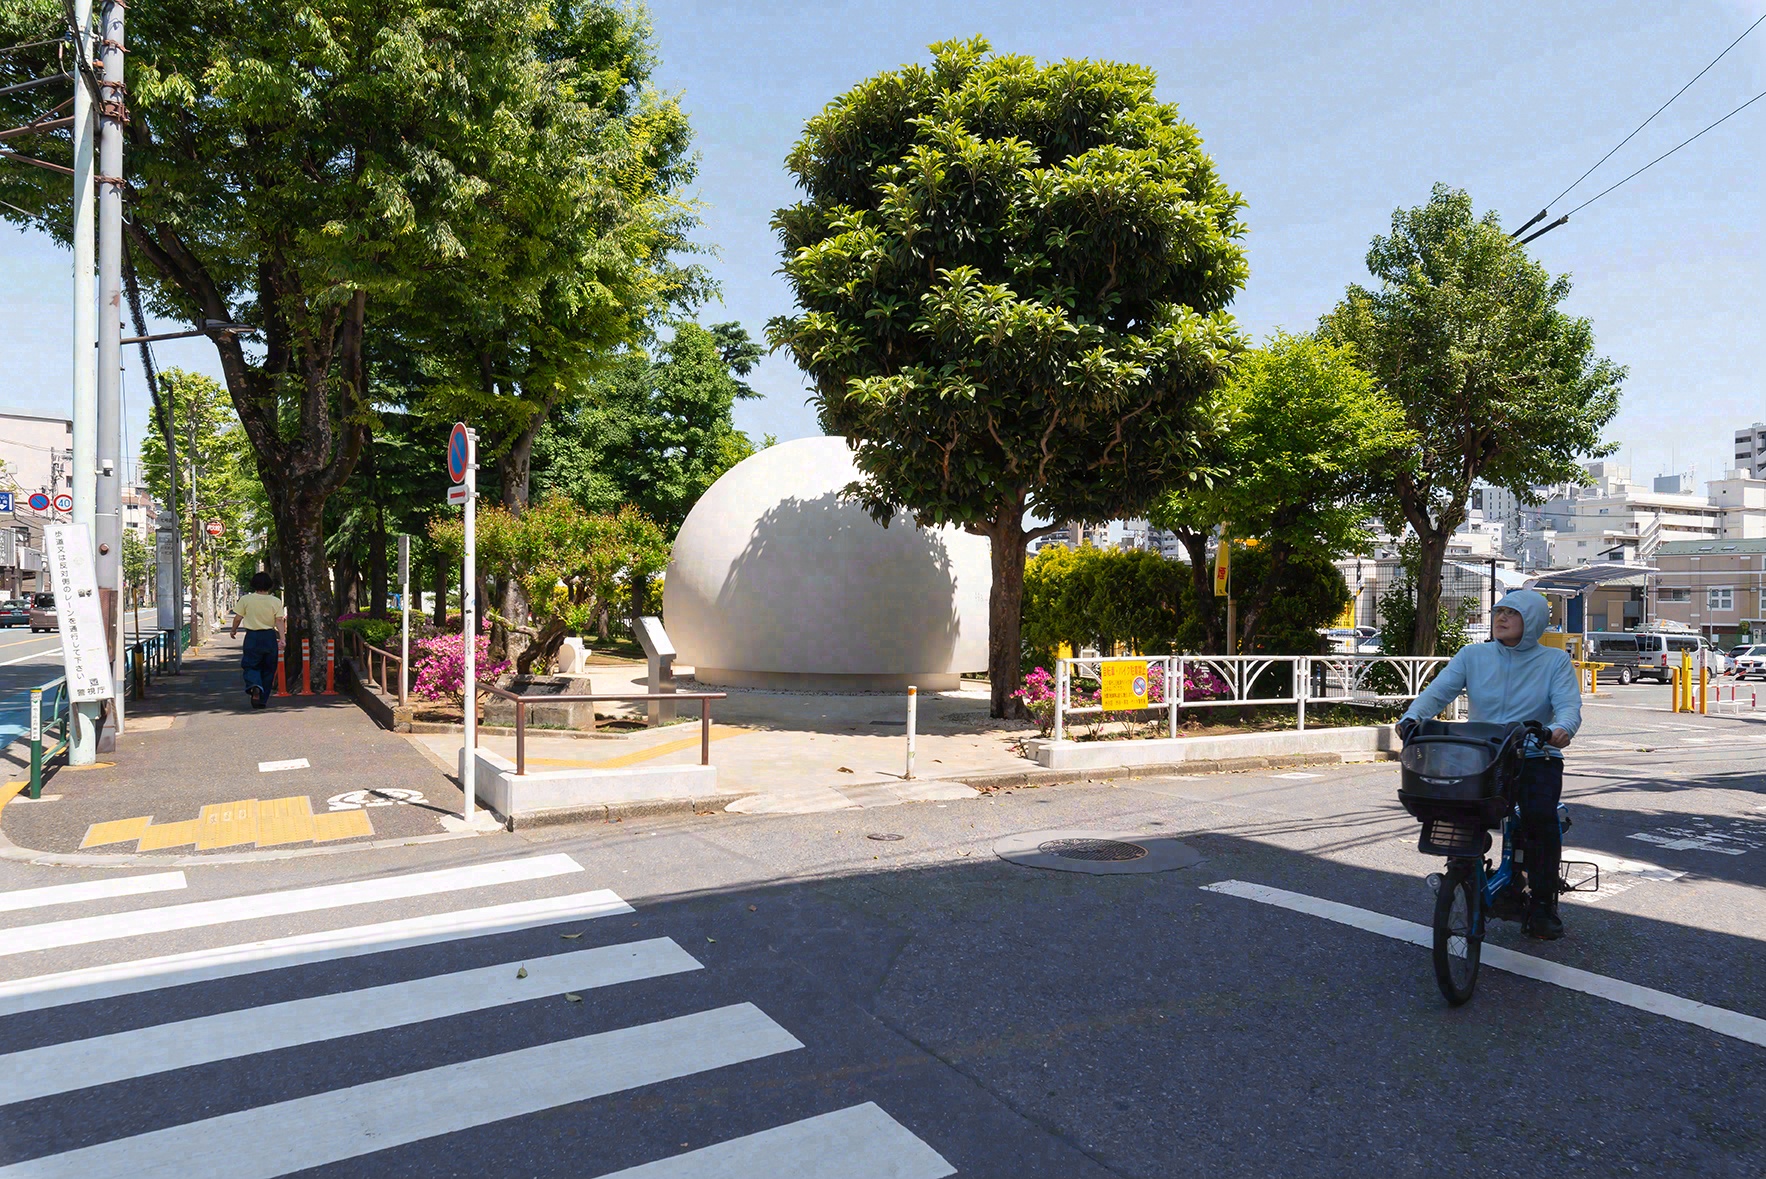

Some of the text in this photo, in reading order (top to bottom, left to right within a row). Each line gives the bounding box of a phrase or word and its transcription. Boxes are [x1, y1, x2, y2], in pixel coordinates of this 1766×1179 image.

[58, 498, 71, 508] 40
[77, 686, 106, 697] 警視庁
